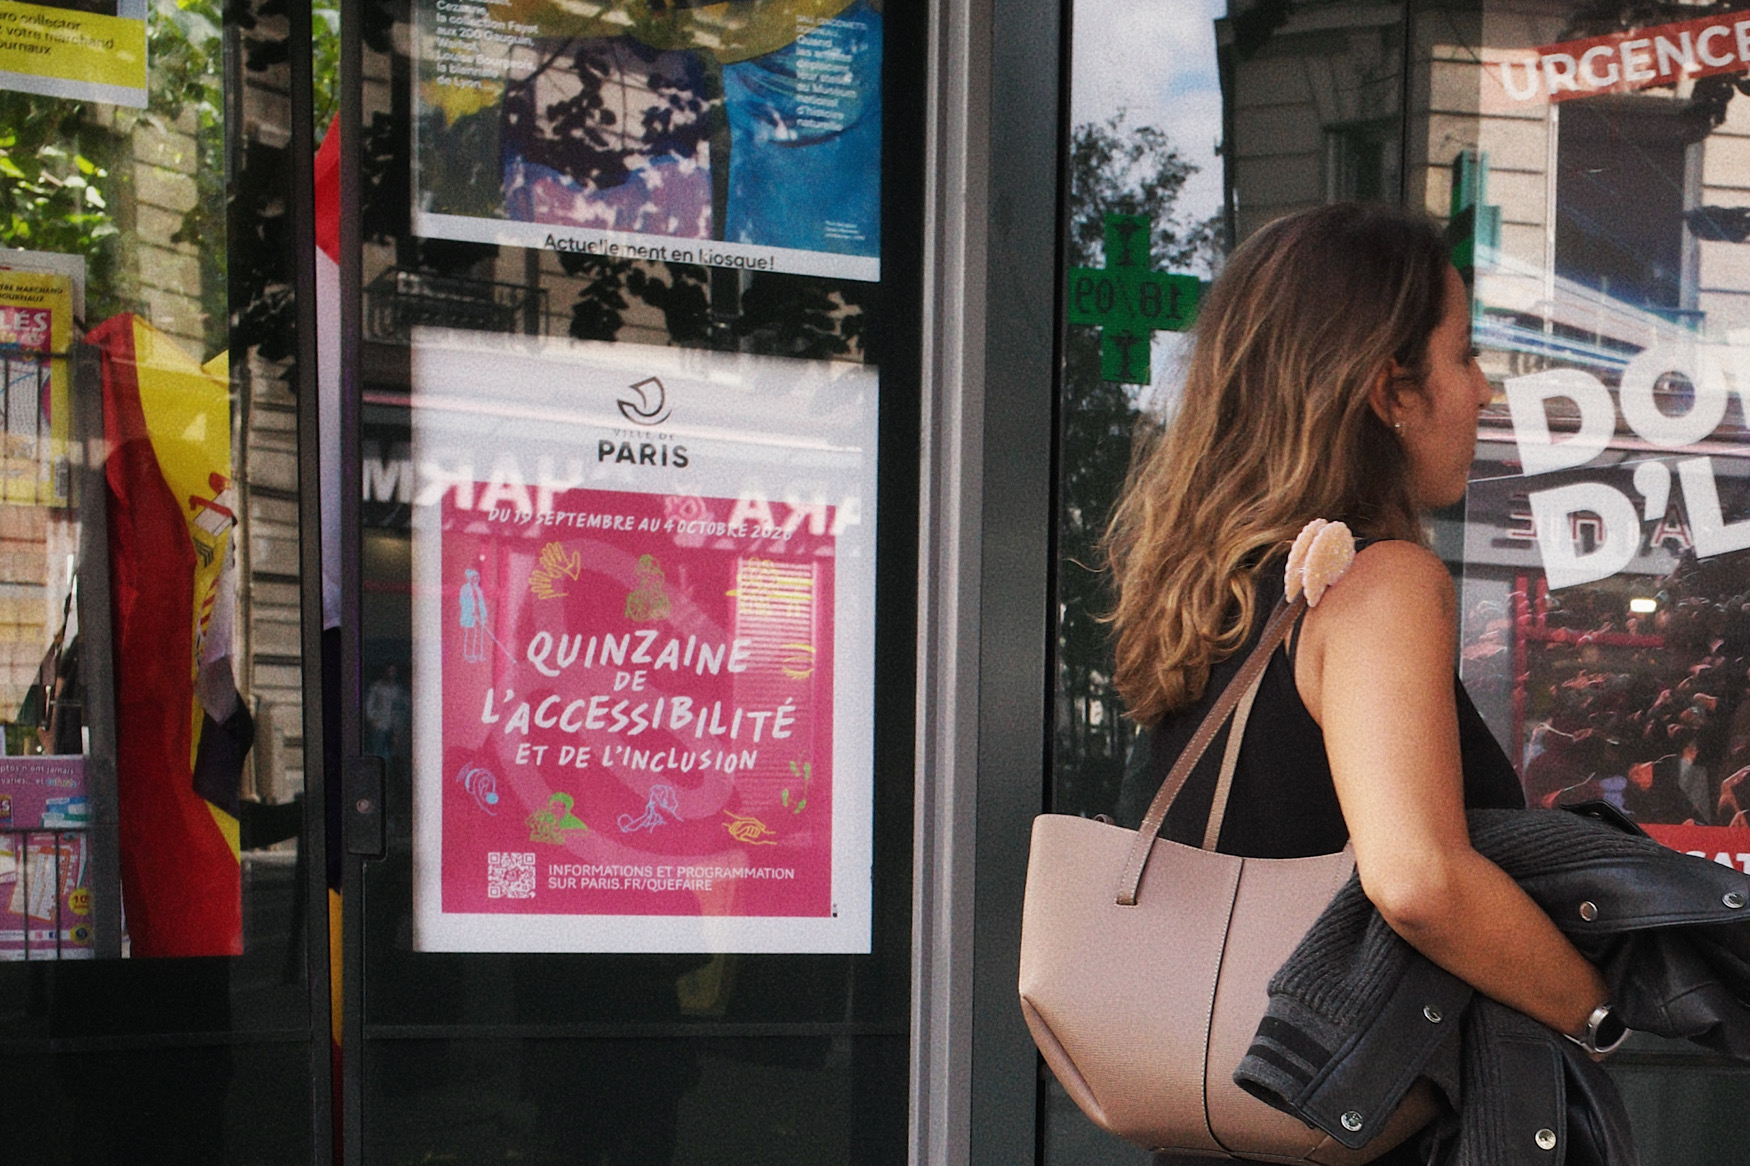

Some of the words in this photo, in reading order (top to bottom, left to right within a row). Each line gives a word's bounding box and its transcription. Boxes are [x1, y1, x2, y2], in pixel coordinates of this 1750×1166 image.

[6, 27, 41, 40] votre
[671, 247, 693, 262] en
[0, 293, 45, 302] OURNAUX
[598, 440, 689, 468] PARIS
[488, 508, 511, 523] DU
[513, 509, 532, 525] 19
[535, 511, 635, 531] SEPTEMBRE
[638, 517, 661, 532] AU
[663, 519, 675, 533] 4
[677, 520, 748, 538] OCTOBRE
[526, 630, 751, 677] QUINZAINE
[613, 670, 647, 692] DE
[481, 688, 797, 743] L'ACCESSIBILITÉ
[515, 743, 549, 766] ET
[558, 745, 591, 769] DE
[602, 745, 758, 774] L'INCLUSION
[548, 864, 653, 878] INFORMATIONS
[656, 866, 672, 878] ET
[677, 866, 795, 880] PROGRAMMATION
[548, 877, 577, 890] SUR
[580, 877, 713, 892] PARIS.FR/QUEFAIRE
